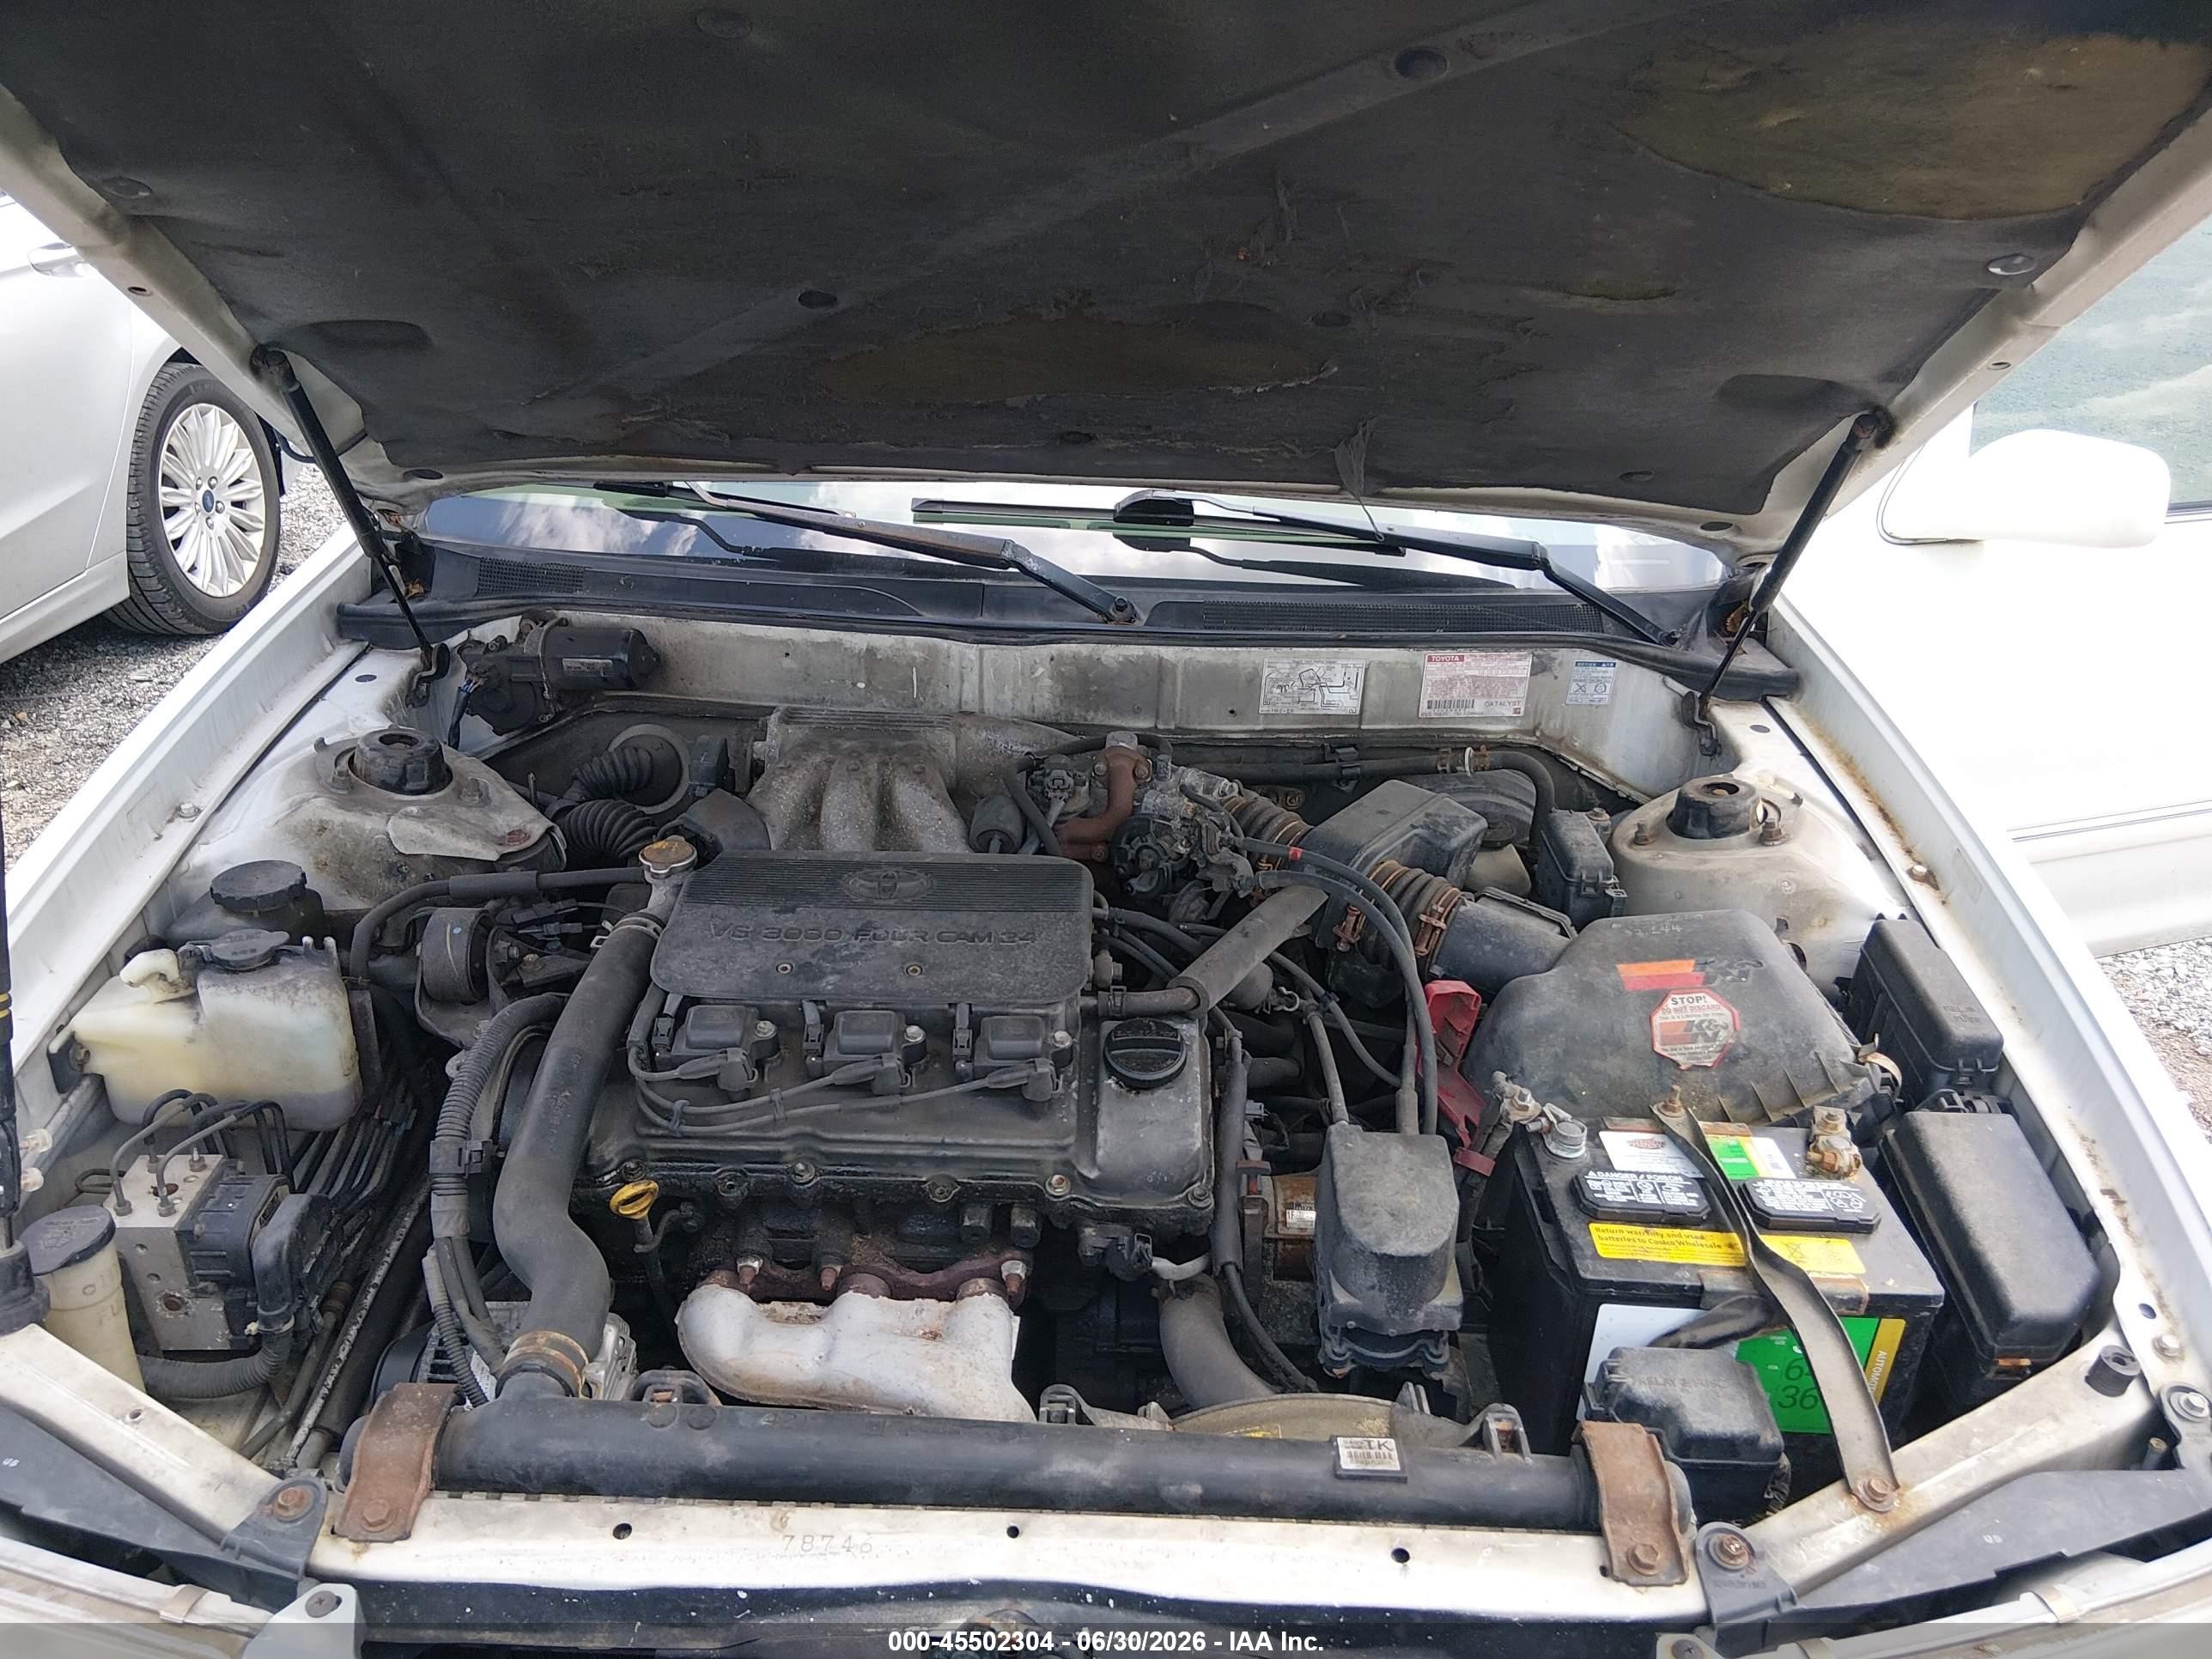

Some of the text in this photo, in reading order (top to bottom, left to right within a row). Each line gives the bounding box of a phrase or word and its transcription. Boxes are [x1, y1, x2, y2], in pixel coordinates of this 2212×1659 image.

[854, 928, 930, 944] FOUR
[935, 930, 994, 945] CAM
[1671, 995, 1707, 1006] STOP!
[1689, 1004, 1721, 1012] DISCARD
[1597, 1171, 1638, 1181] DANGER
[1646, 1174, 1683, 1182] POISON
[1598, 1235, 1636, 1243] batteries
[1676, 1240, 1723, 1249] Wholesale
[1778, 1385, 1819, 1410] 36
[782, 1534, 873, 1553] 78746
